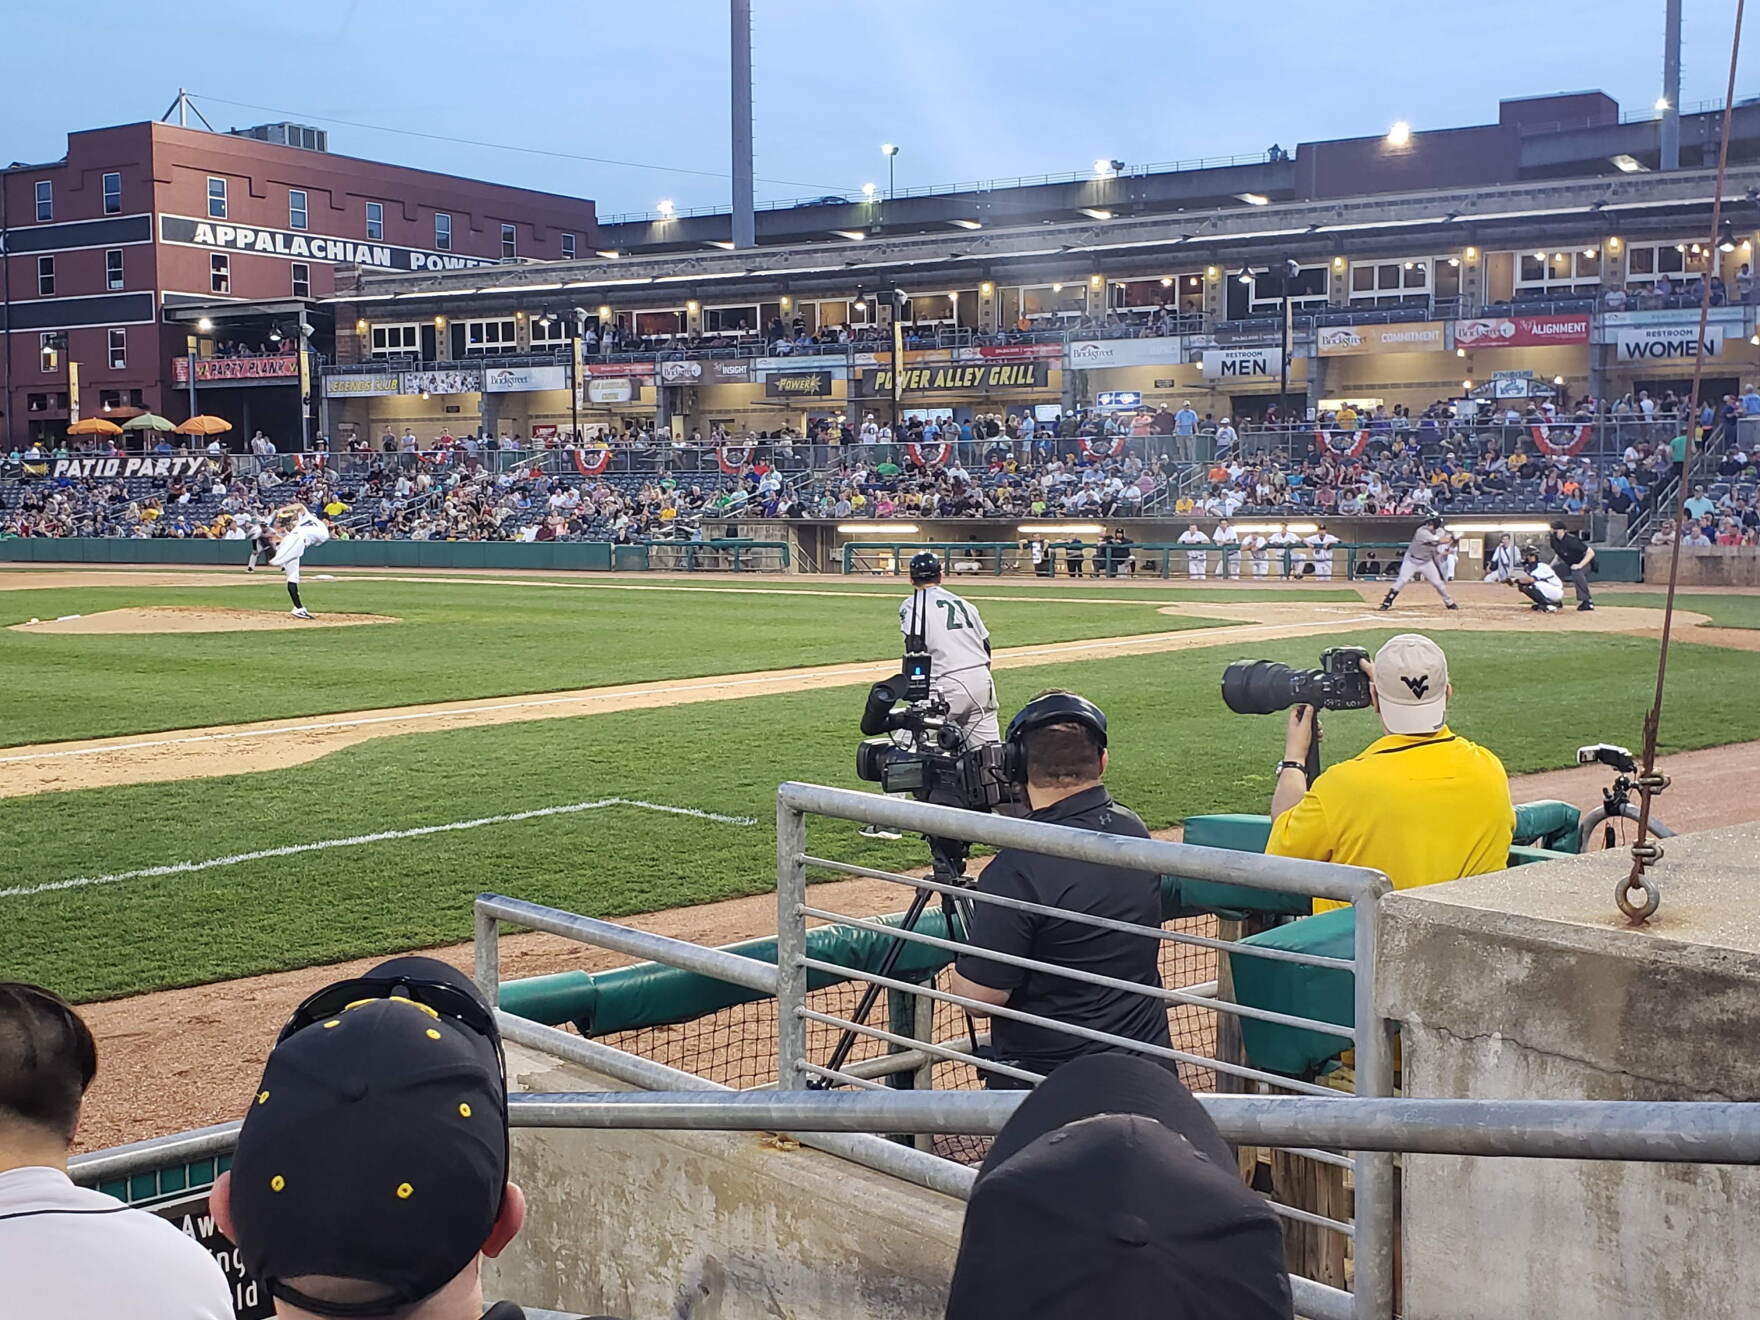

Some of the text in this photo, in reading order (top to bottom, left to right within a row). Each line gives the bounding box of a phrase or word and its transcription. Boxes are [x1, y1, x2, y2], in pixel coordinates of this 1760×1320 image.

[193, 223, 493, 271] APPALACHIAN POW
[1531, 320, 1587, 335] ALIGNMENT
[1646, 329, 1693, 338] RESTROOM
[1380, 330, 1441, 343] COMMITMENT
[1225, 350, 1263, 359] RESTROOM
[1625, 339, 1715, 359] WOMEN
[210, 360, 286, 376] PARTY PLANK
[722, 363, 748, 375] INSIGHT
[1220, 358, 1267, 377] MEN
[934, 366, 985, 388] ALLEY
[989, 364, 1035, 386] GRILL
[328, 379, 399, 393] LEGENDS CLUB
[53, 458, 121, 478] PATIO
[124, 456, 205, 477] PARTY
[936, 599, 974, 631] 21
